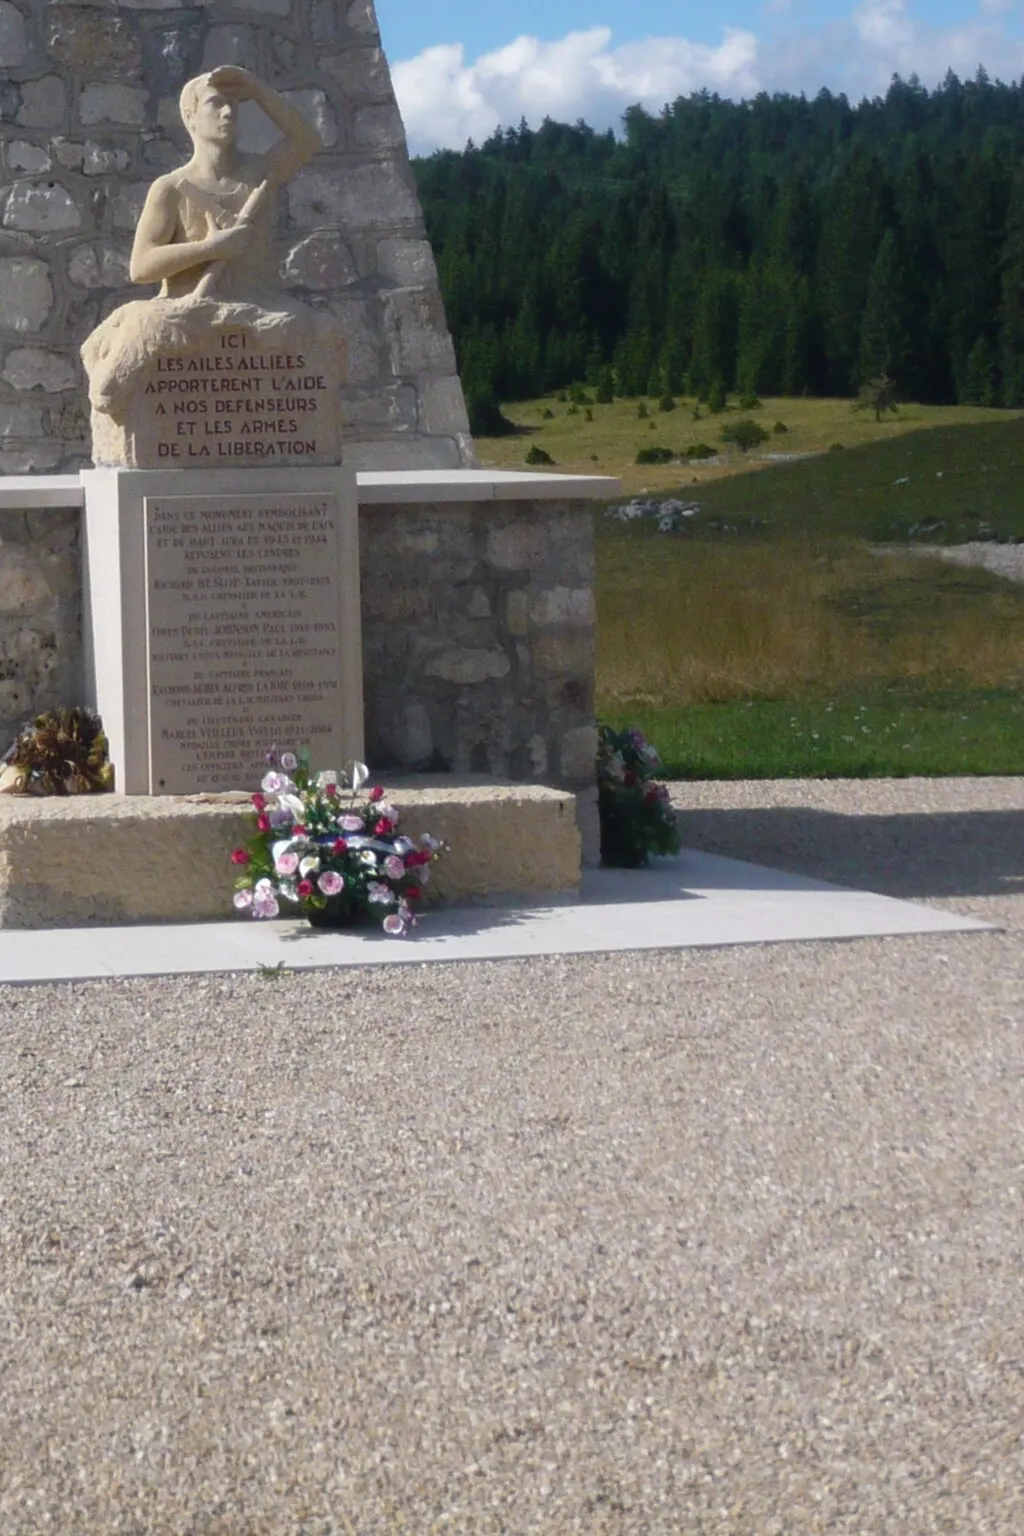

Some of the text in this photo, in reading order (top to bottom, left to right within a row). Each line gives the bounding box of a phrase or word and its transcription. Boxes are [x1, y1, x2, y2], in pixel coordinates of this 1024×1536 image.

[221, 334, 246, 349] ICI
[157, 355, 306, 372] LES AILES ALLIEES
[144, 376, 327, 394] APPORTERENT L'AIDE
[155, 398, 317, 415] A NOS DEFENSEURS
[177, 419, 298, 436] ET LES ARMES
[158, 440, 316, 457] DE LA LIBERATION
[200, 509, 252, 520] MONUMENT
